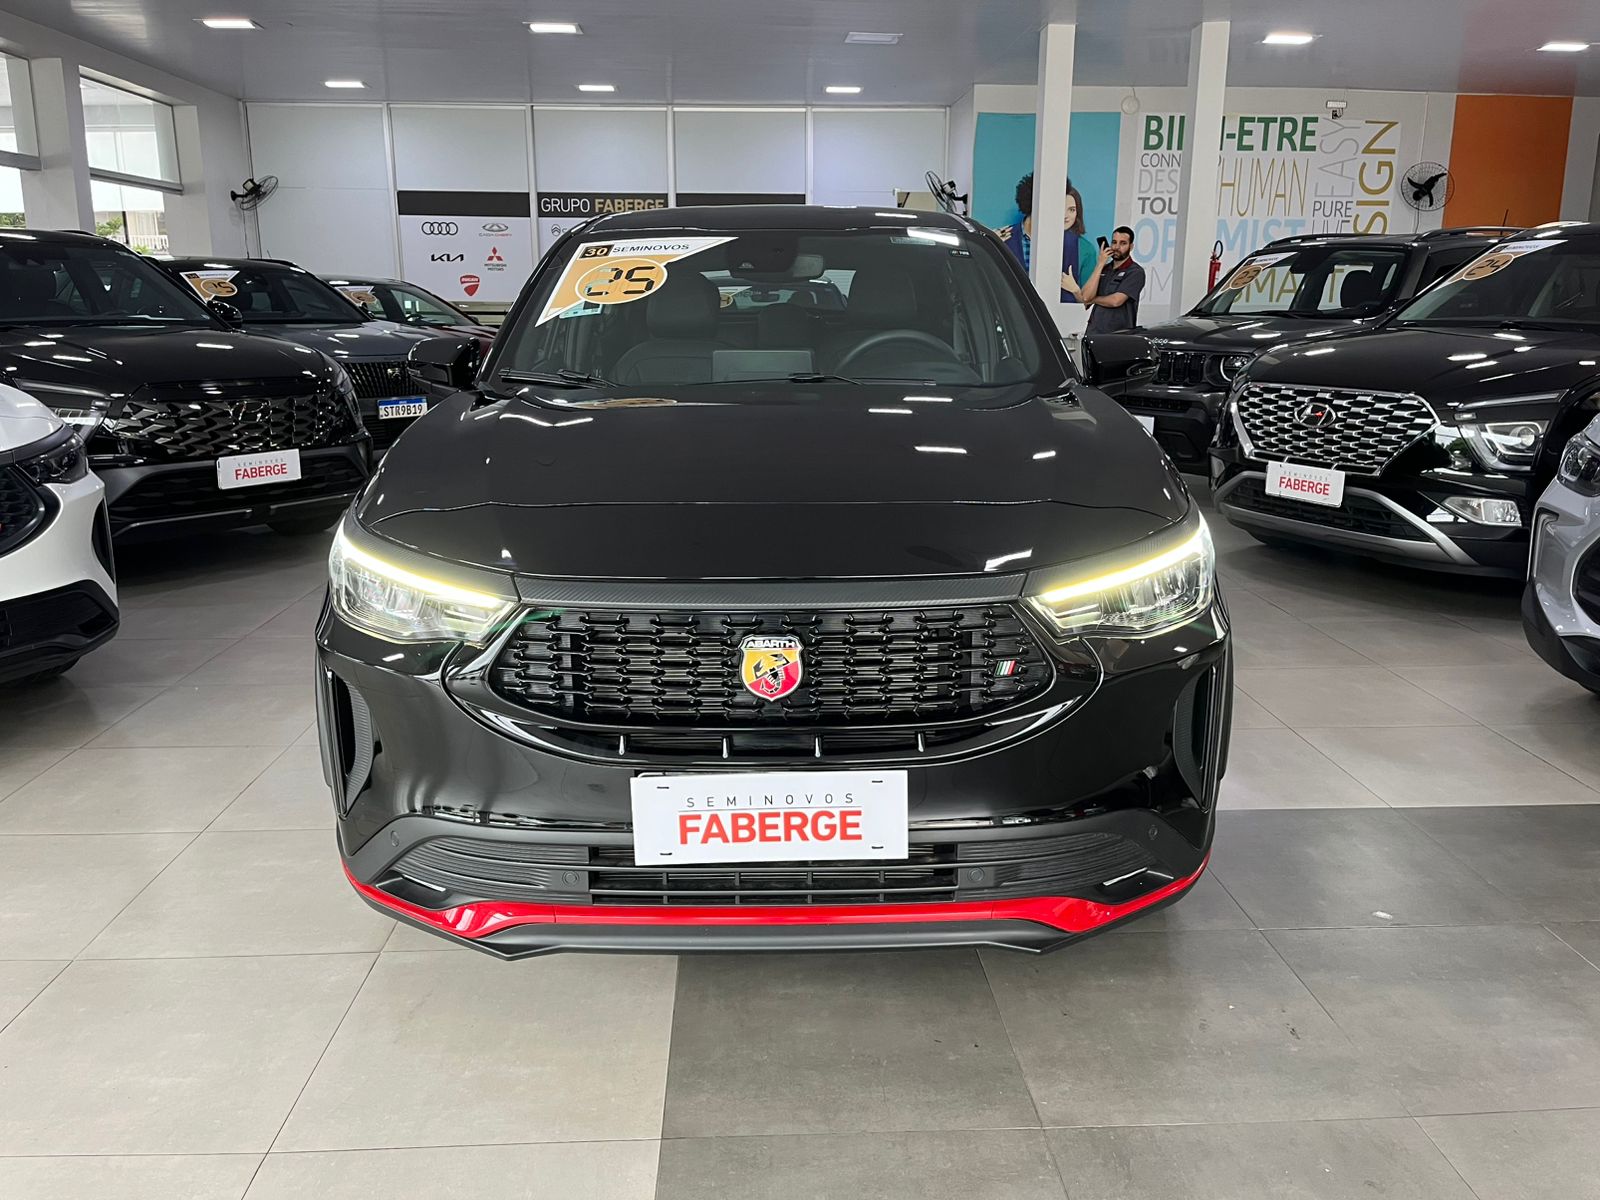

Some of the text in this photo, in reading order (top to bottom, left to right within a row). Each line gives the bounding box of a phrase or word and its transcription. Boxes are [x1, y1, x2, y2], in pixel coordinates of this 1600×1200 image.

[1143, 115, 1319, 151] BI-ETRE
[1315, 117, 1361, 197] EASY
[1138, 168, 1179, 194] DES
[1217, 157, 1310, 217] HUMAN
[541, 197, 665, 213] GRUPO FABERGE
[1137, 196, 1179, 215] TOU
[1312, 200, 1354, 218] PURE
[430, 253, 464, 262] KIA
[584, 244, 690, 257] 30 SEMINOVOS
[383, 404, 423, 417] STR9B19
[235, 463, 288, 480] FABERGE
[1279, 476, 1330, 496] FABERGE
[746, 639, 796, 648] ABARTH
[686, 793, 854, 808] SEMINOVOS
[678, 810, 863, 845] FABERGE
